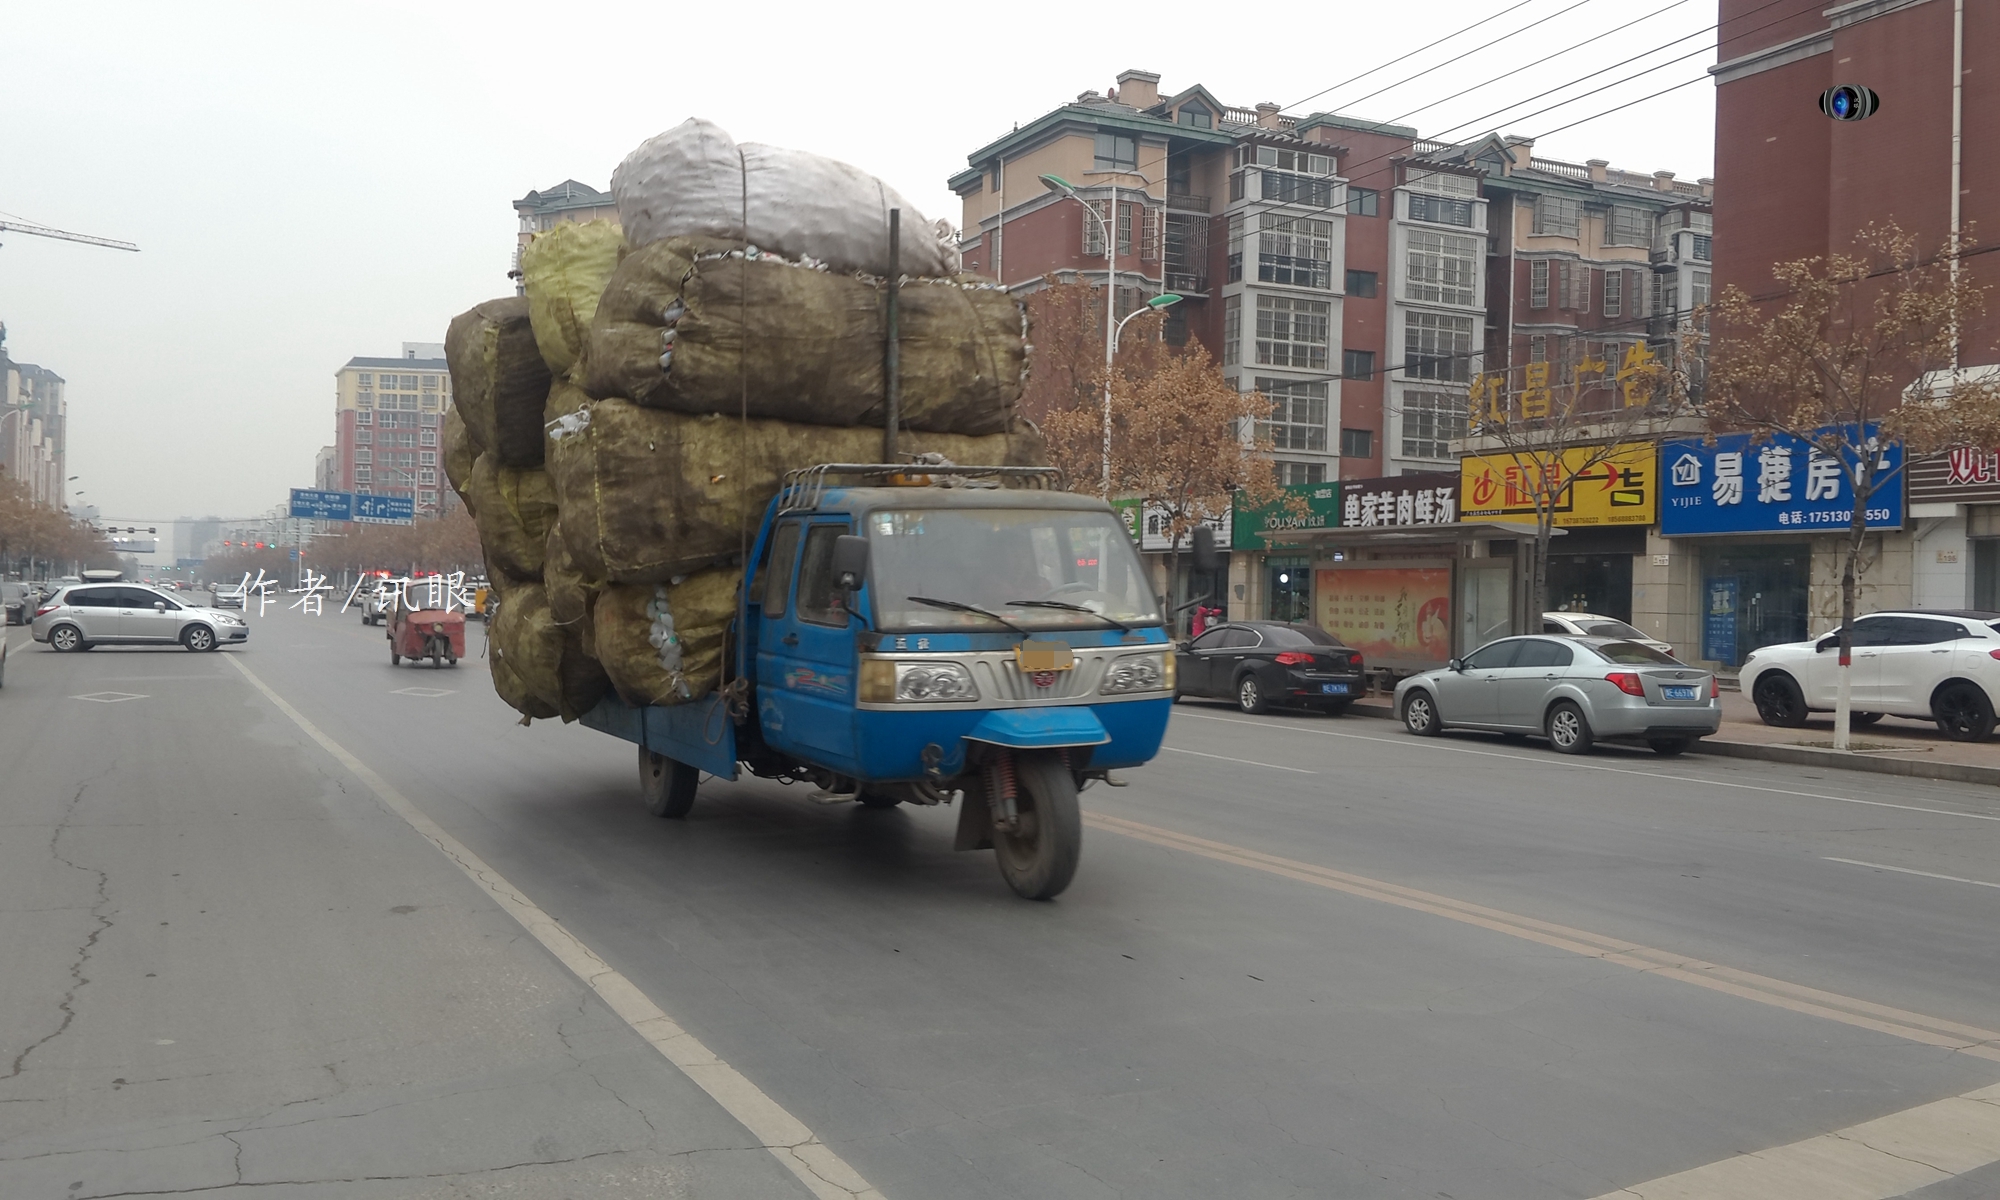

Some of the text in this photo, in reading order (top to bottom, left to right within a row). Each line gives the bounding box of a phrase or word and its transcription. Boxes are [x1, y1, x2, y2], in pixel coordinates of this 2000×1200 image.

[1469, 339, 1656, 429] 红昌广告
[1343, 487, 1455, 527] 单家羊肉鲜汤
[1671, 496, 1702, 508] YIJIE
[1778, 508, 1890, 524] 电话:175130550
